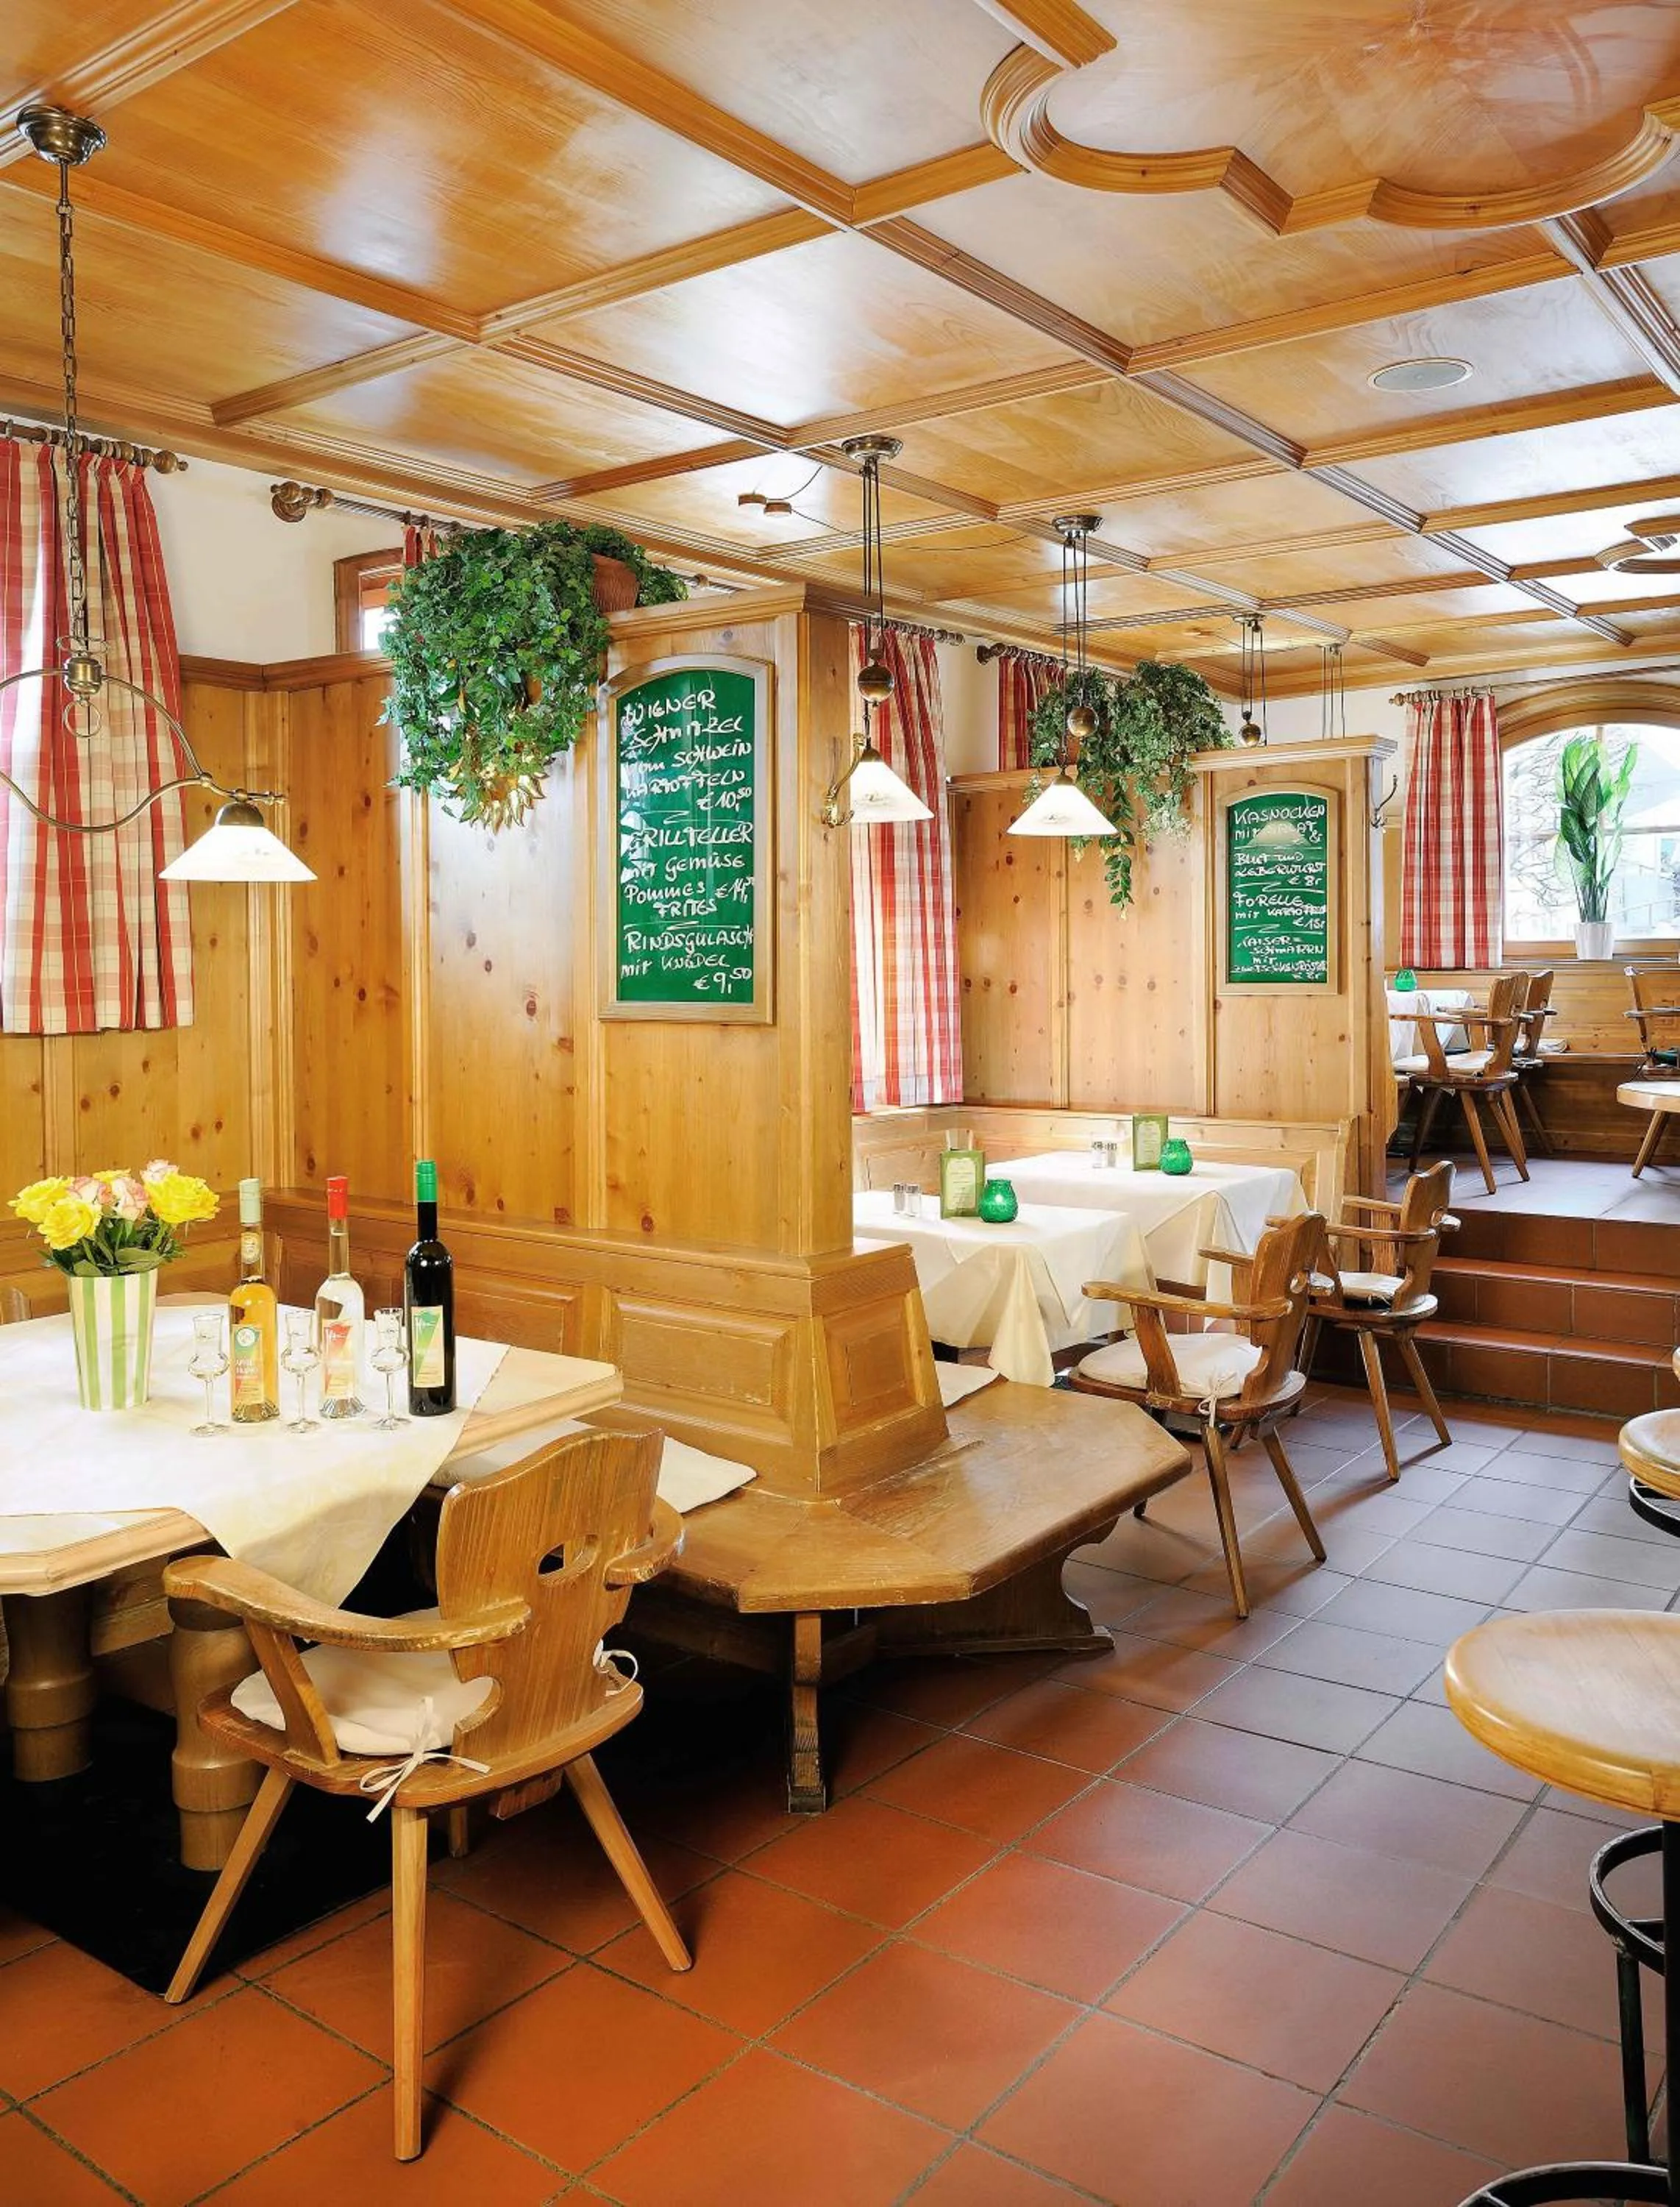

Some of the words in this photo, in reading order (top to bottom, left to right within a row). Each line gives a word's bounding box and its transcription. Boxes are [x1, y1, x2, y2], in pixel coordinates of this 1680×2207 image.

[624, 689, 716, 726] WIENER
[627, 716, 744, 755] SCHNITZEL
[671, 739, 752, 772] SCHWEIN
[1234, 804, 1325, 825] KASNOCKEN
[652, 899, 718, 918] FRITES
[1233, 891, 1304, 908] FORELLE
